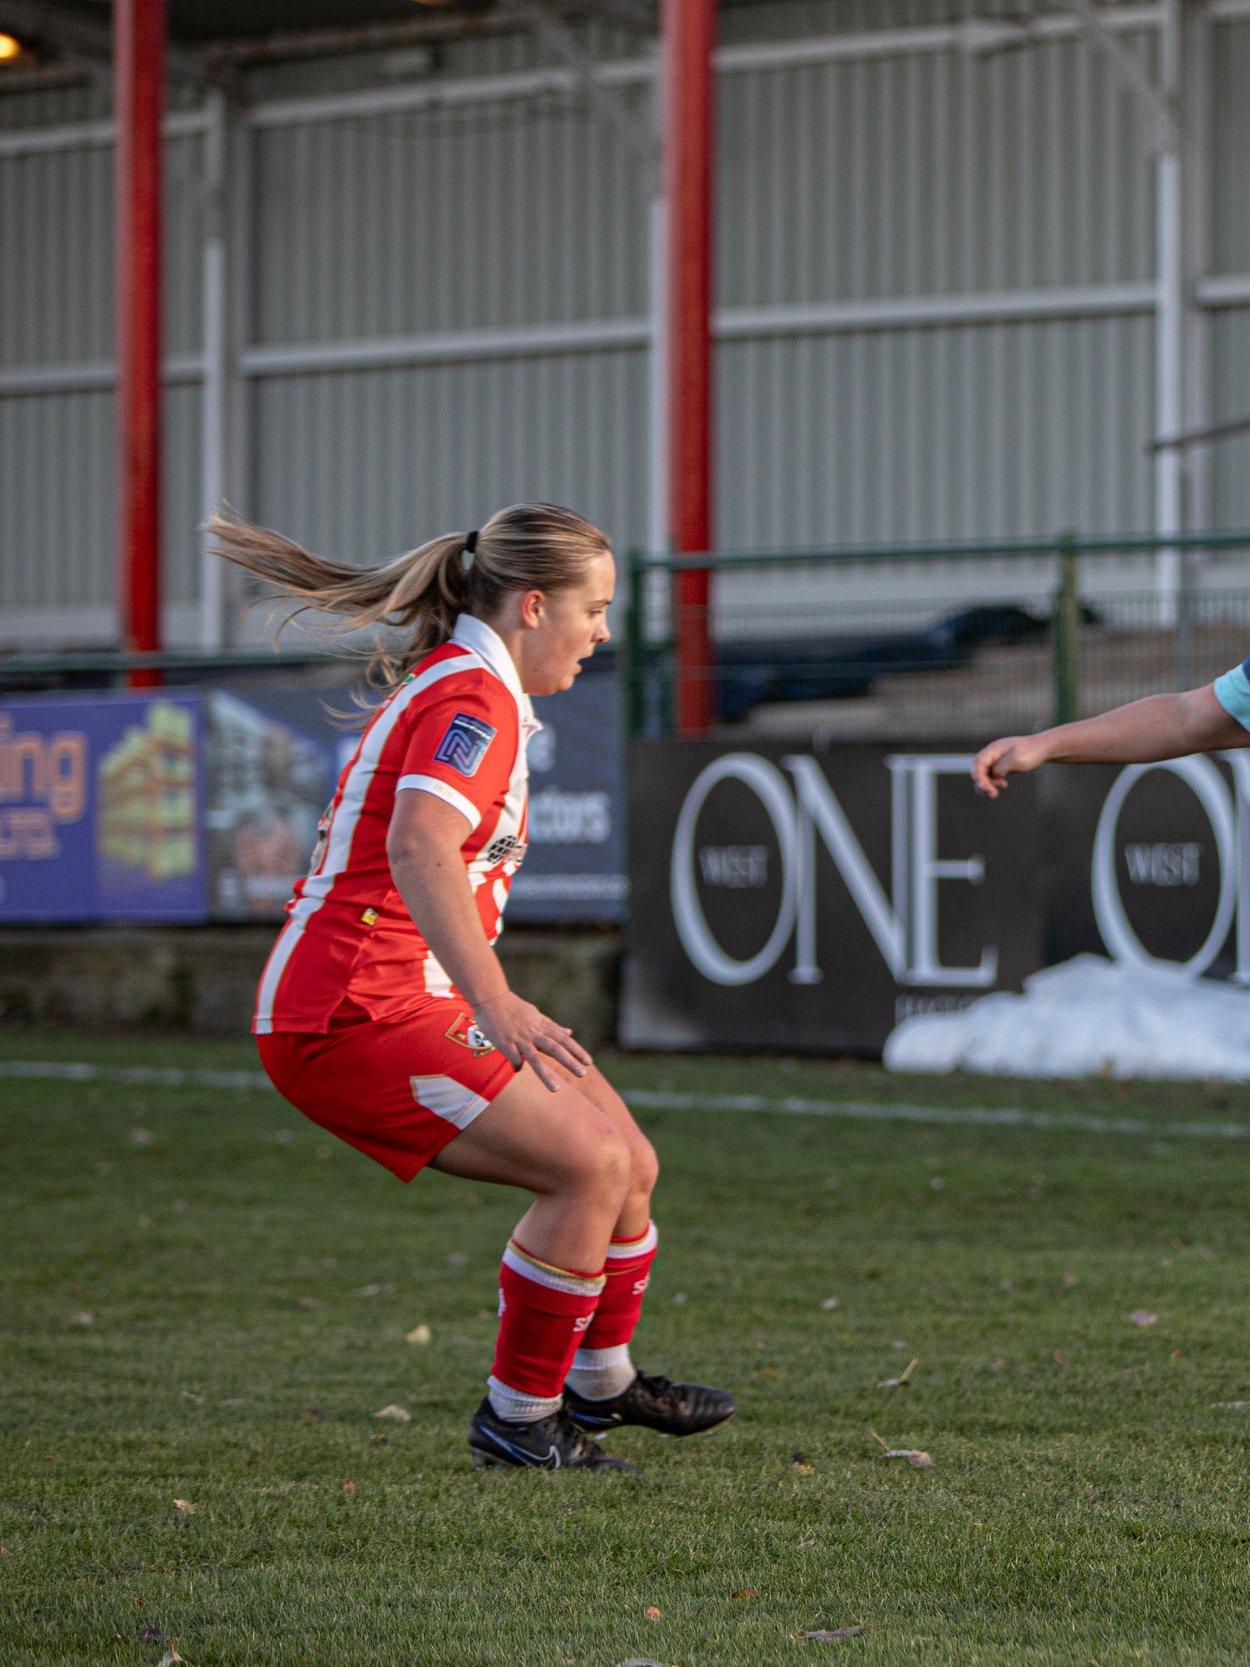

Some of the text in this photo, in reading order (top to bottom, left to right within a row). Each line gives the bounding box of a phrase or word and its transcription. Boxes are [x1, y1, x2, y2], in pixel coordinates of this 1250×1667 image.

[670, 751, 1000, 987] ONE
[700, 845, 767, 888] WEST
[1124, 842, 1199, 887] WEST
